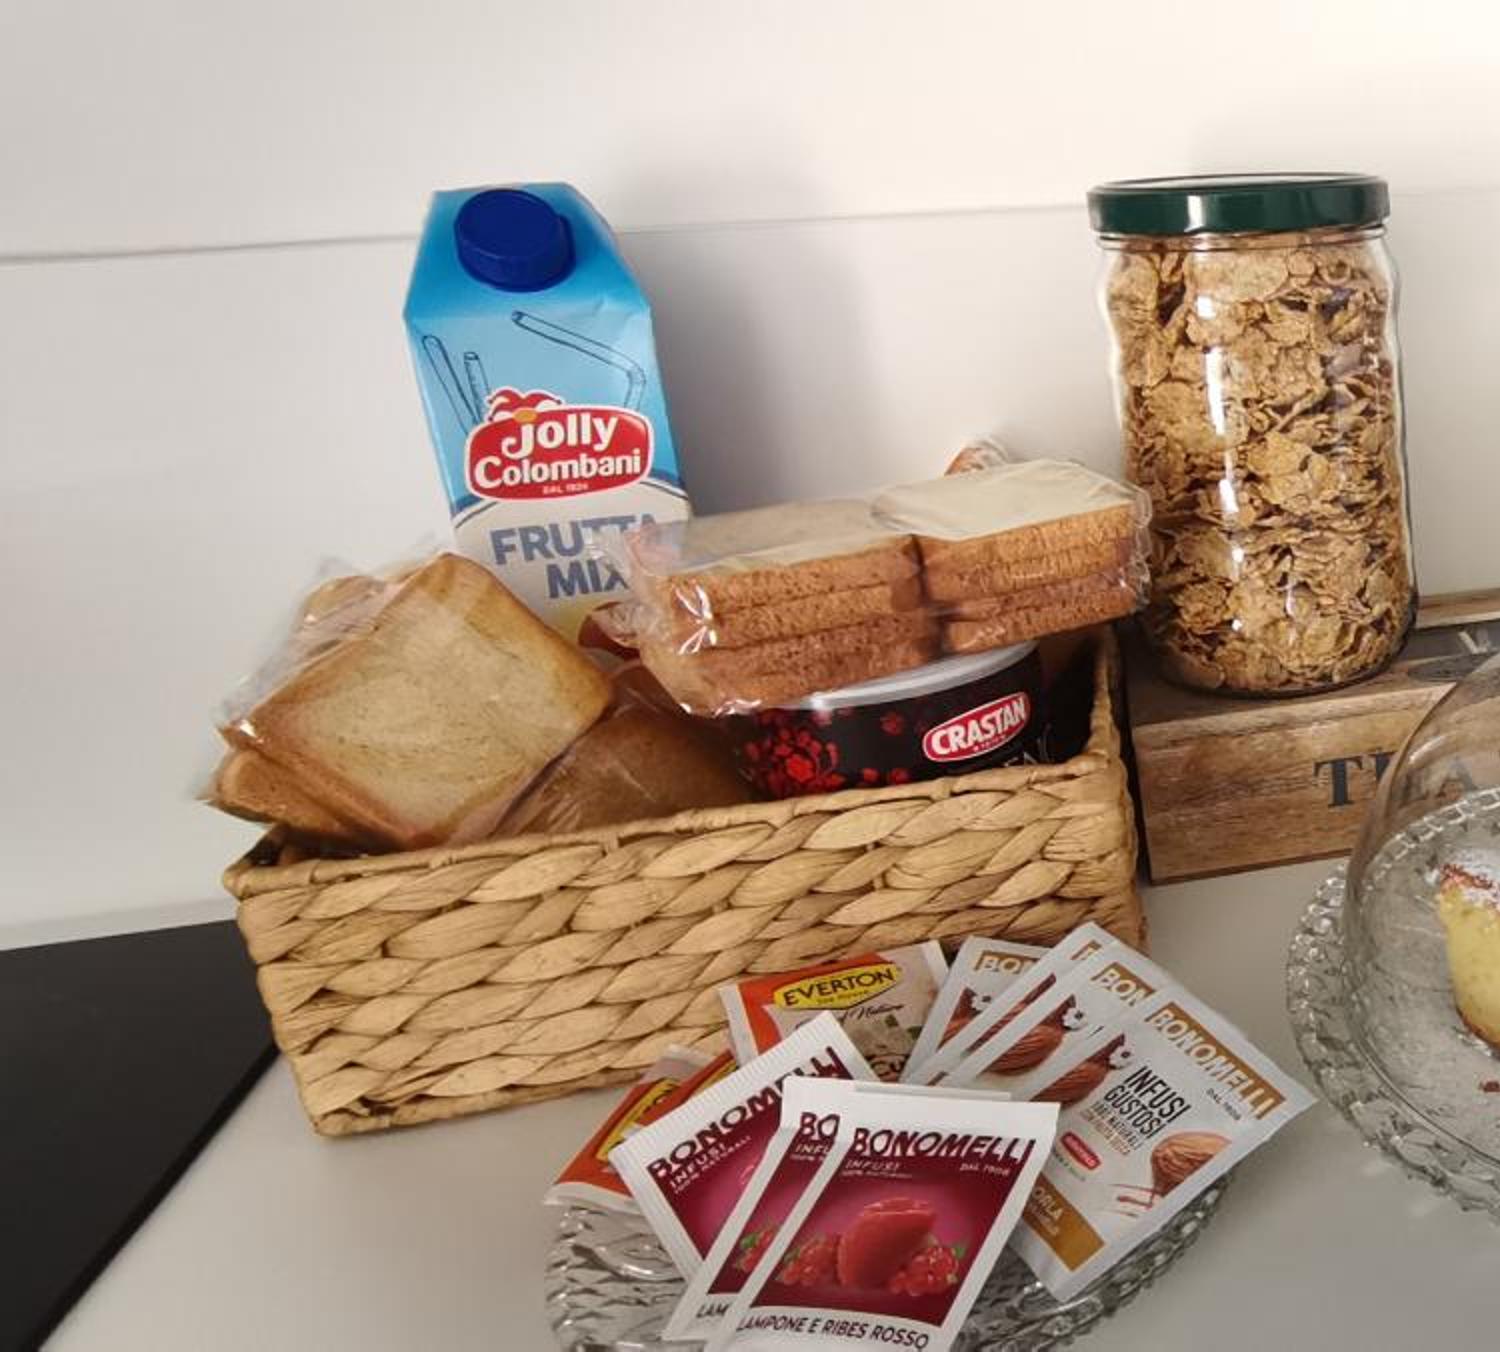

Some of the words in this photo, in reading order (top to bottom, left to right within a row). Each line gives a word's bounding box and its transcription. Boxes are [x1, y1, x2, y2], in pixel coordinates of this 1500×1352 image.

[501, 412, 618, 459] Jolly
[474, 448, 641, 489] Colombani
[489, 513, 657, 565] FRUTT
[931, 697, 1026, 755] CRASTAN
[1314, 746, 1478, 806] TA
[783, 968, 895, 1006] EVERTON
[1154, 1008, 1276, 1121] BONOMELLI
[1103, 1084, 1168, 1140] GUSTOSI
[1123, 1064, 1193, 1124] INFUSI
[670, 1144, 727, 1188] INFUSI
[851, 1127, 1037, 1165] BONOMELLI
[736, 1313, 808, 1333] LAMPONE
[807, 1317, 818, 1334] E
[821, 1318, 867, 1339] RIBES
[869, 1324, 930, 1350] ROSSO
